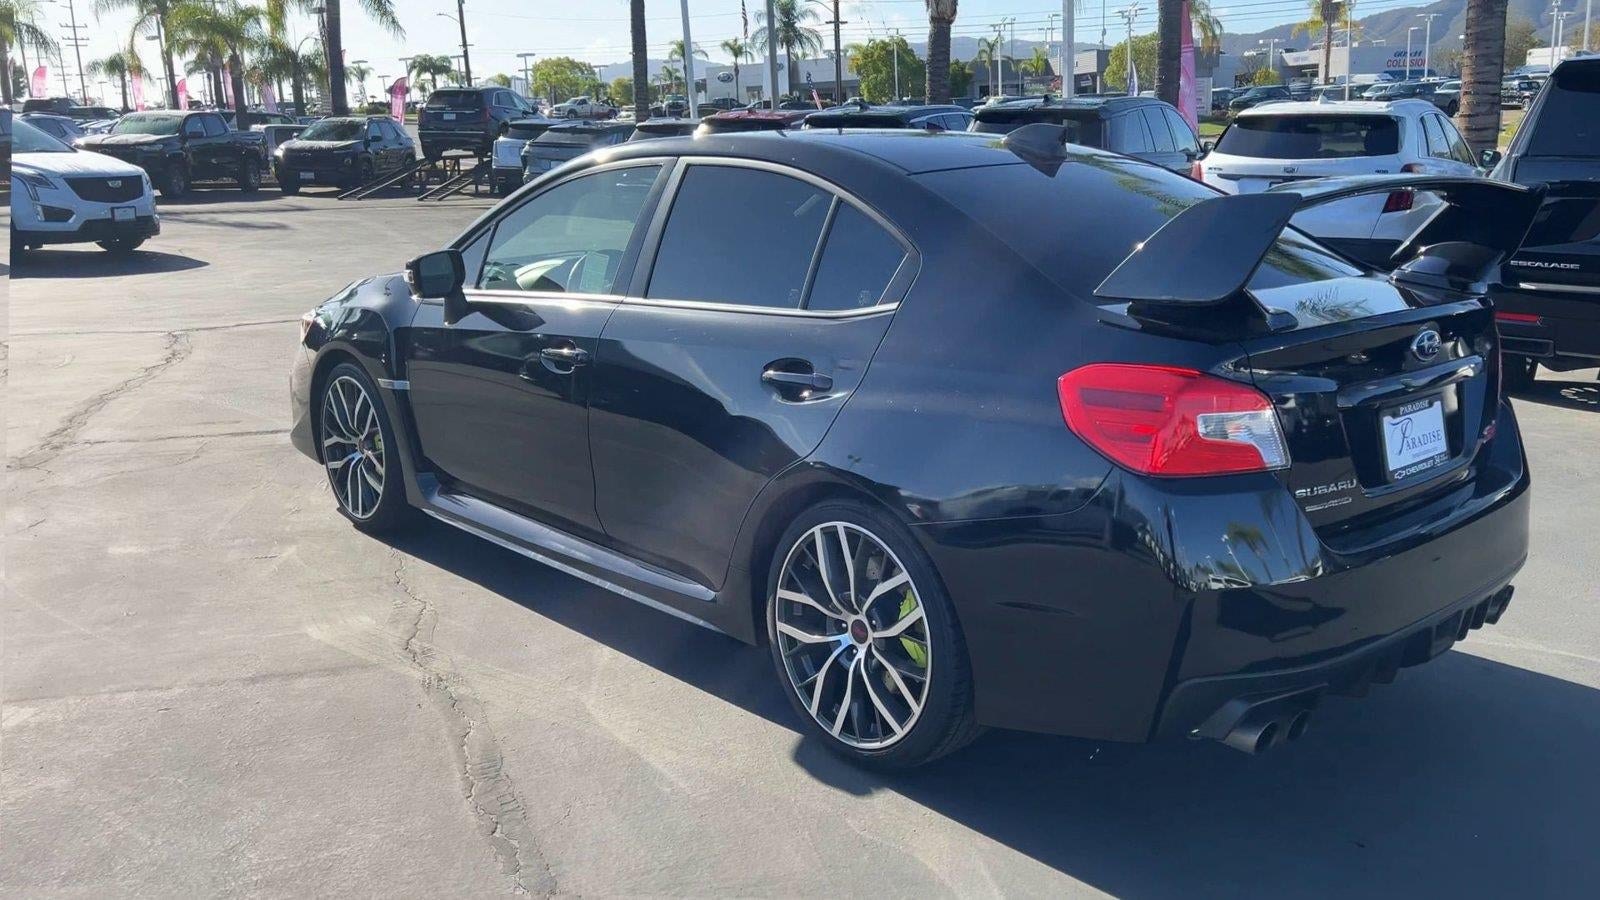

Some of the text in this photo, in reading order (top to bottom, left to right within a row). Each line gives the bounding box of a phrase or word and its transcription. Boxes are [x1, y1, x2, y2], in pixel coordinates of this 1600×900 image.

[1386, 58, 1429, 68] COLLSIO
[1510, 260, 1580, 270] ESCALADE
[1399, 399, 1430, 415] PARADISE
[1389, 417, 1443, 456] PARADISE
[1405, 459, 1434, 476] CHEVROLET
[1294, 478, 1357, 498] SUBARU
